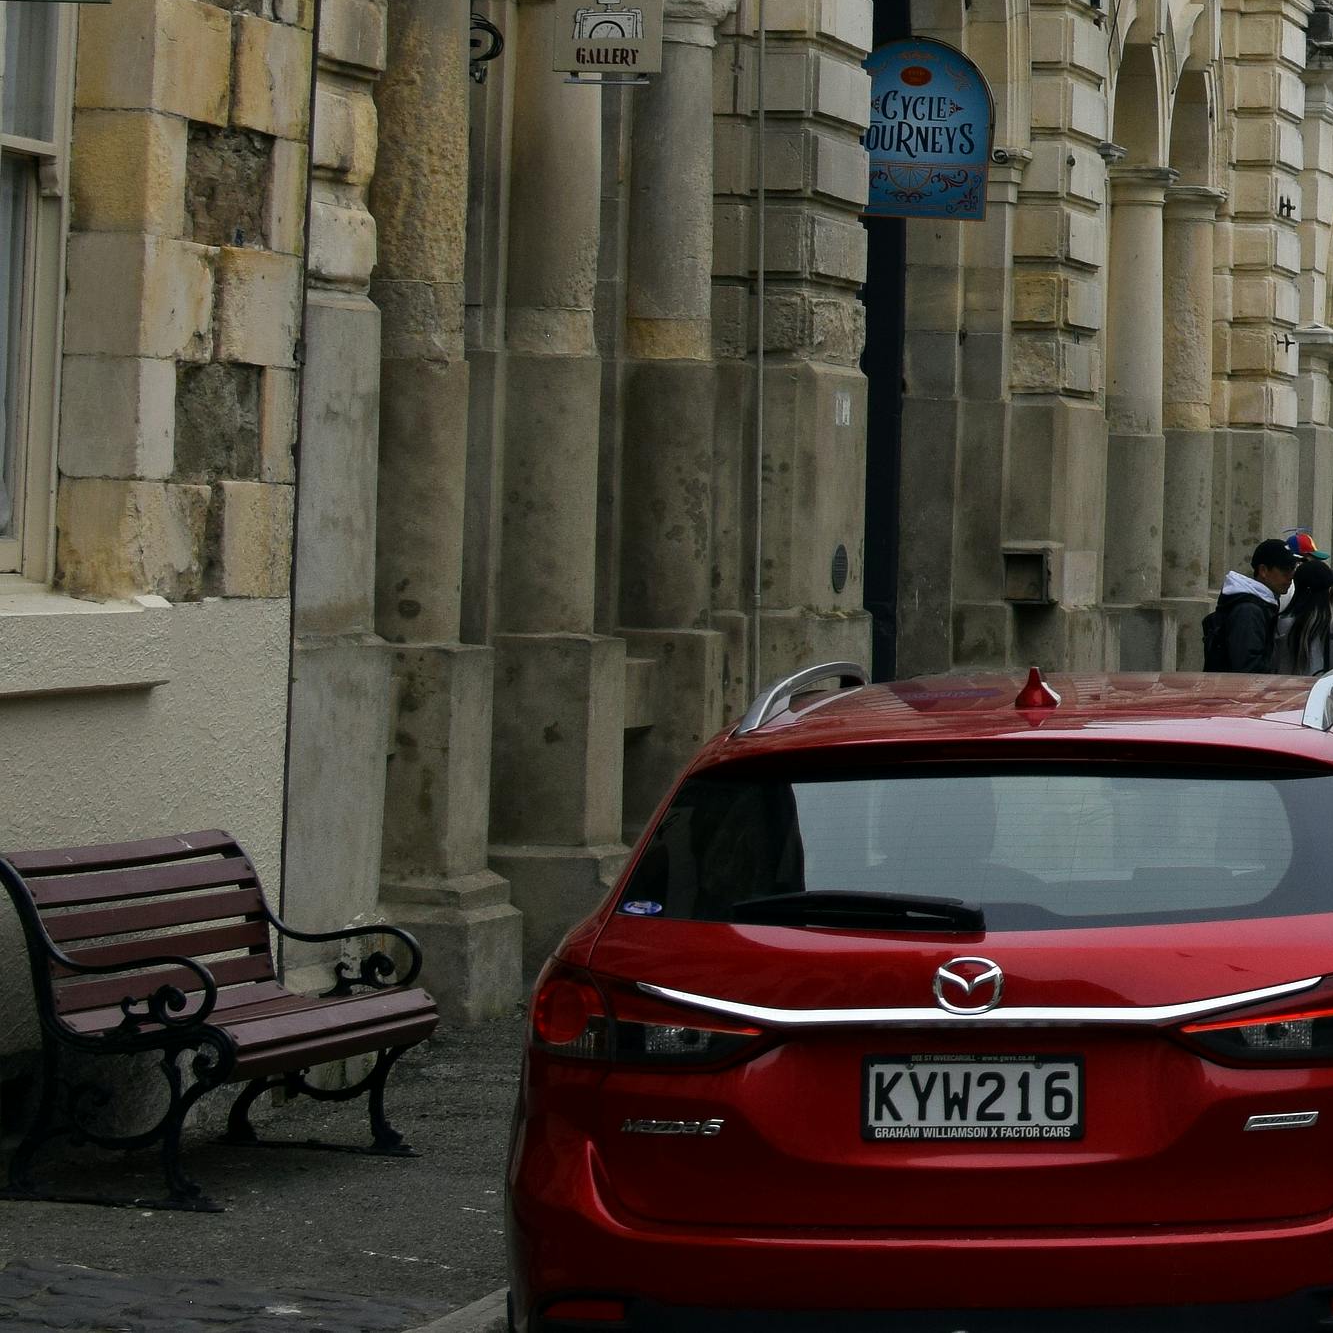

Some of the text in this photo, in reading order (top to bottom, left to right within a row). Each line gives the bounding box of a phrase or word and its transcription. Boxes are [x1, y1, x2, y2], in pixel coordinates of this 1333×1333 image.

[575, 47, 639, 66] GALLERY
[881, 90, 948, 122] CYCLE
[865, 121, 975, 158] OURNEYS
[873, 1070, 1074, 1122] KYW216
[874, 1126, 1071, 1138] GRAHAM WILLIAMSON X FACTOR CARS
